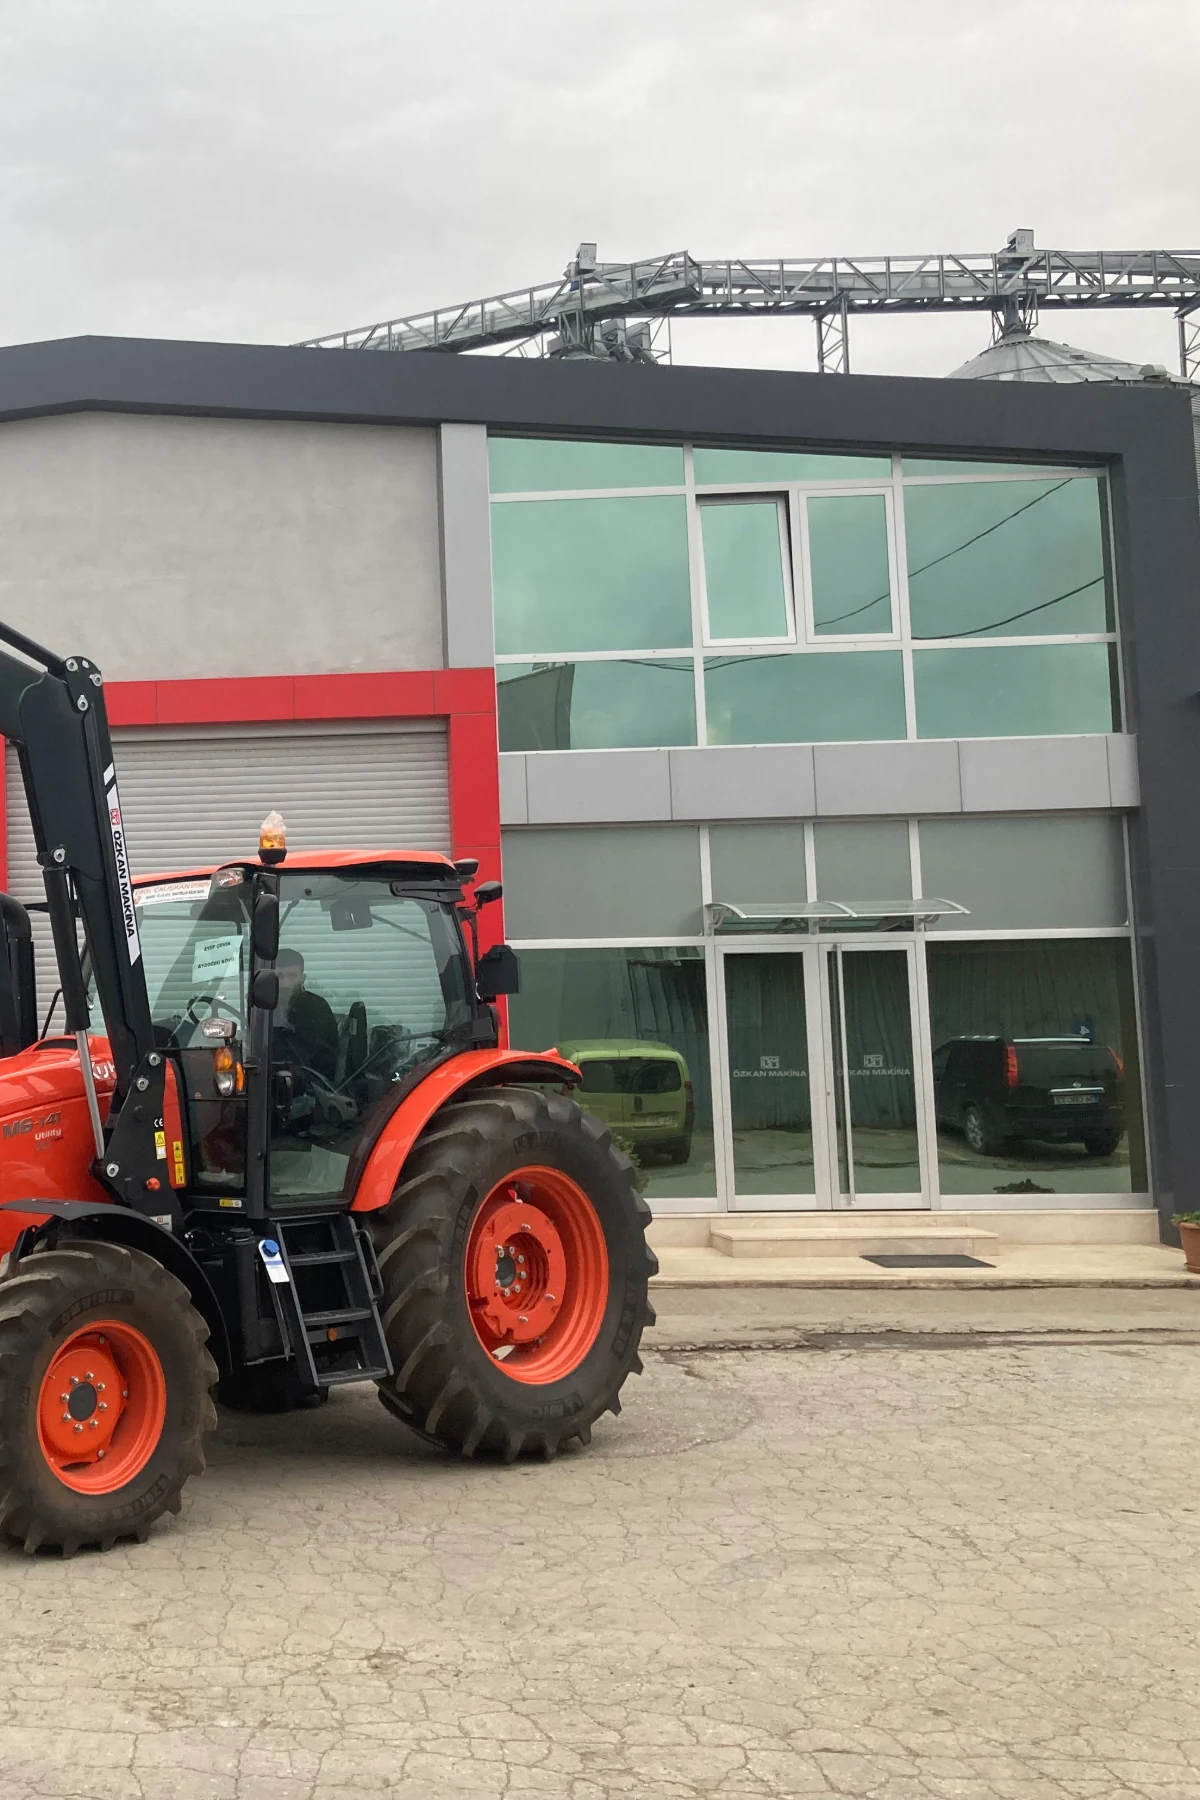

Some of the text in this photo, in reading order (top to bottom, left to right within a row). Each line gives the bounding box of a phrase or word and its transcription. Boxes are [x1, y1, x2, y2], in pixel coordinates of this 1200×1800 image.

[113, 830, 135, 938] ÖZKAN MAKİNA
[733, 1068, 807, 1078] ÖZKAN MAKİNA
[872, 1067, 911, 1076] MAKİNA
[34, 1128, 62, 1141] Utility
